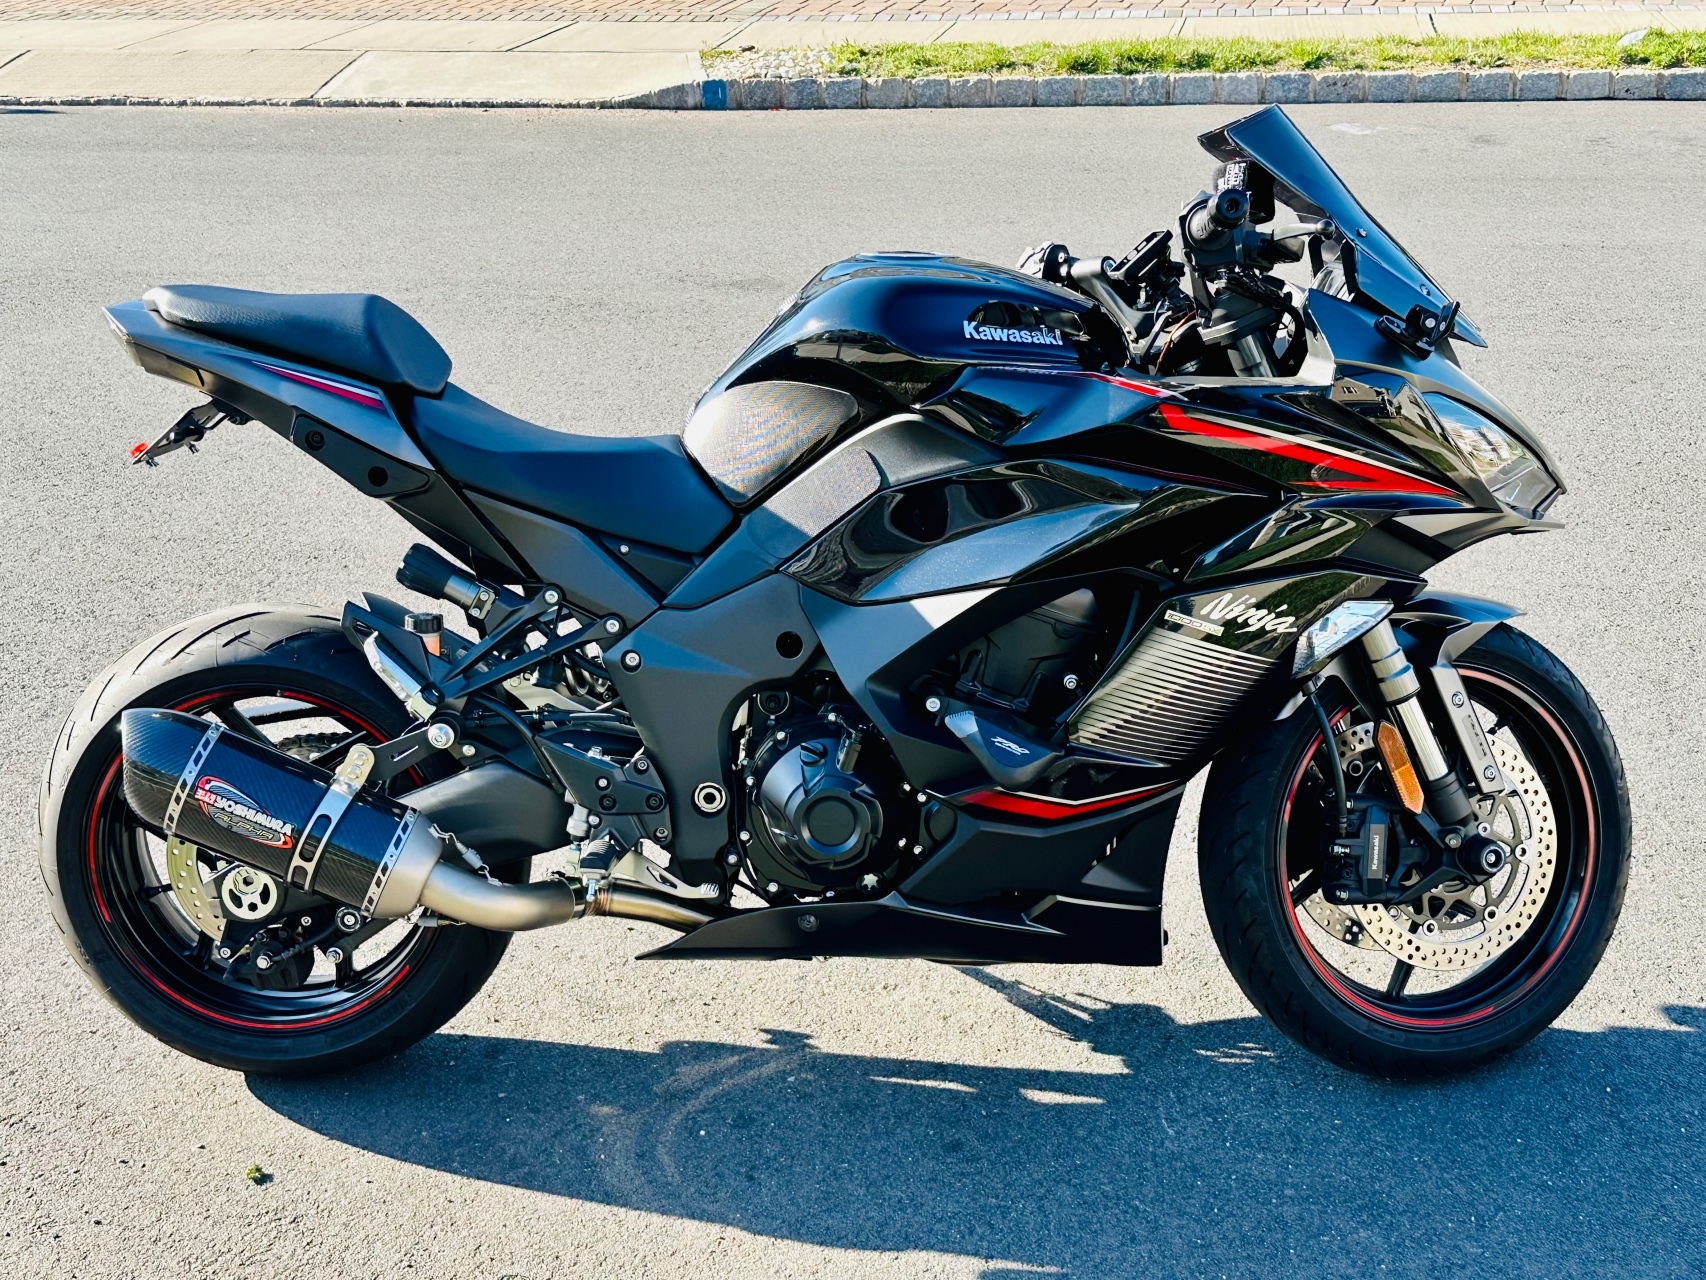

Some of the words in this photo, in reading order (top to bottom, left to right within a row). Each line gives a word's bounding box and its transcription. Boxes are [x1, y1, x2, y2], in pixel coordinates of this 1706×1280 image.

[963, 320, 1063, 345] Kawasaki
[1200, 592, 1298, 634] Ninja
[214, 794, 292, 836] YOSHIMURA
[1371, 835, 1380, 870] Kawasaki
